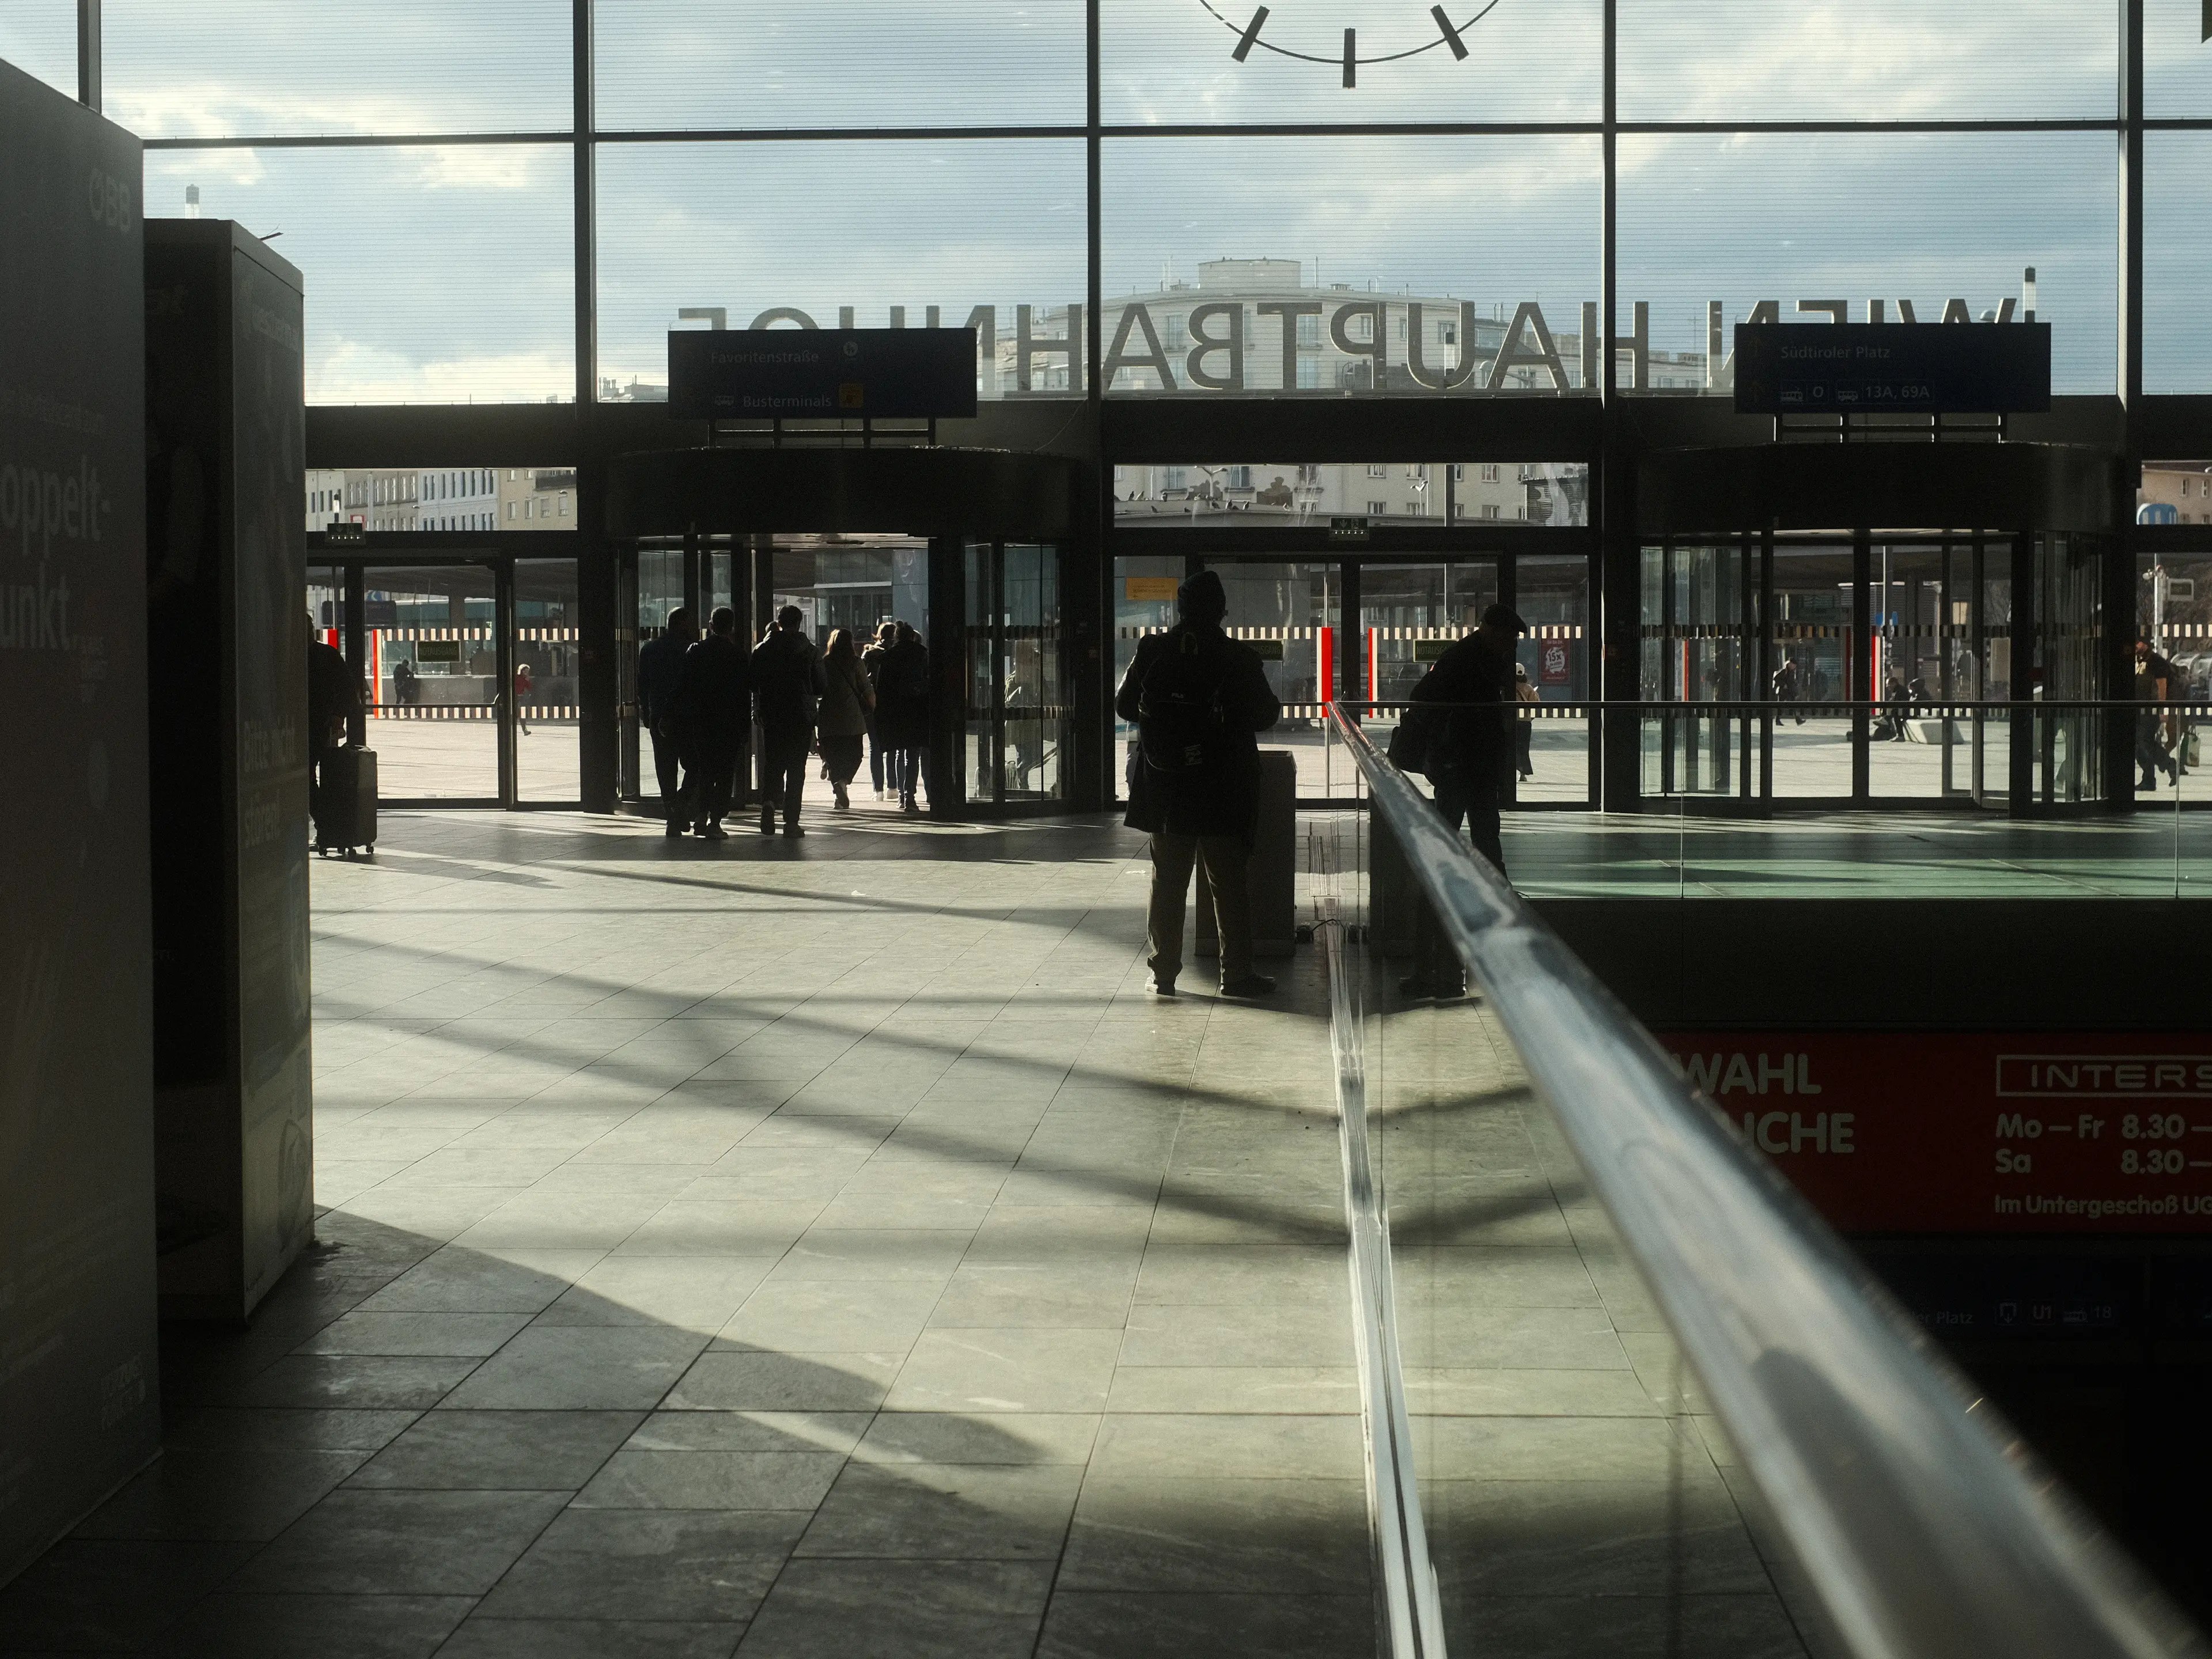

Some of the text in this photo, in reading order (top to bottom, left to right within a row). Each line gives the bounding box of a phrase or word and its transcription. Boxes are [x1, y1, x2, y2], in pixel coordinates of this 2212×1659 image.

[711, 350, 819, 363] Favoritenstraße
[1781, 346, 1891, 359] Südtiroler Platz
[1902, 386, 1930, 397] 69A
[743, 395, 832, 407] Busterminals
[2122, 1113, 2186, 1139] 8.30
[1995, 1148, 2032, 1173] Sa
[2121, 1149, 2184, 1175] 8.30
[1995, 1194, 2021, 1214] Im
[2025, 1194, 2178, 1219] Untergeschoß
